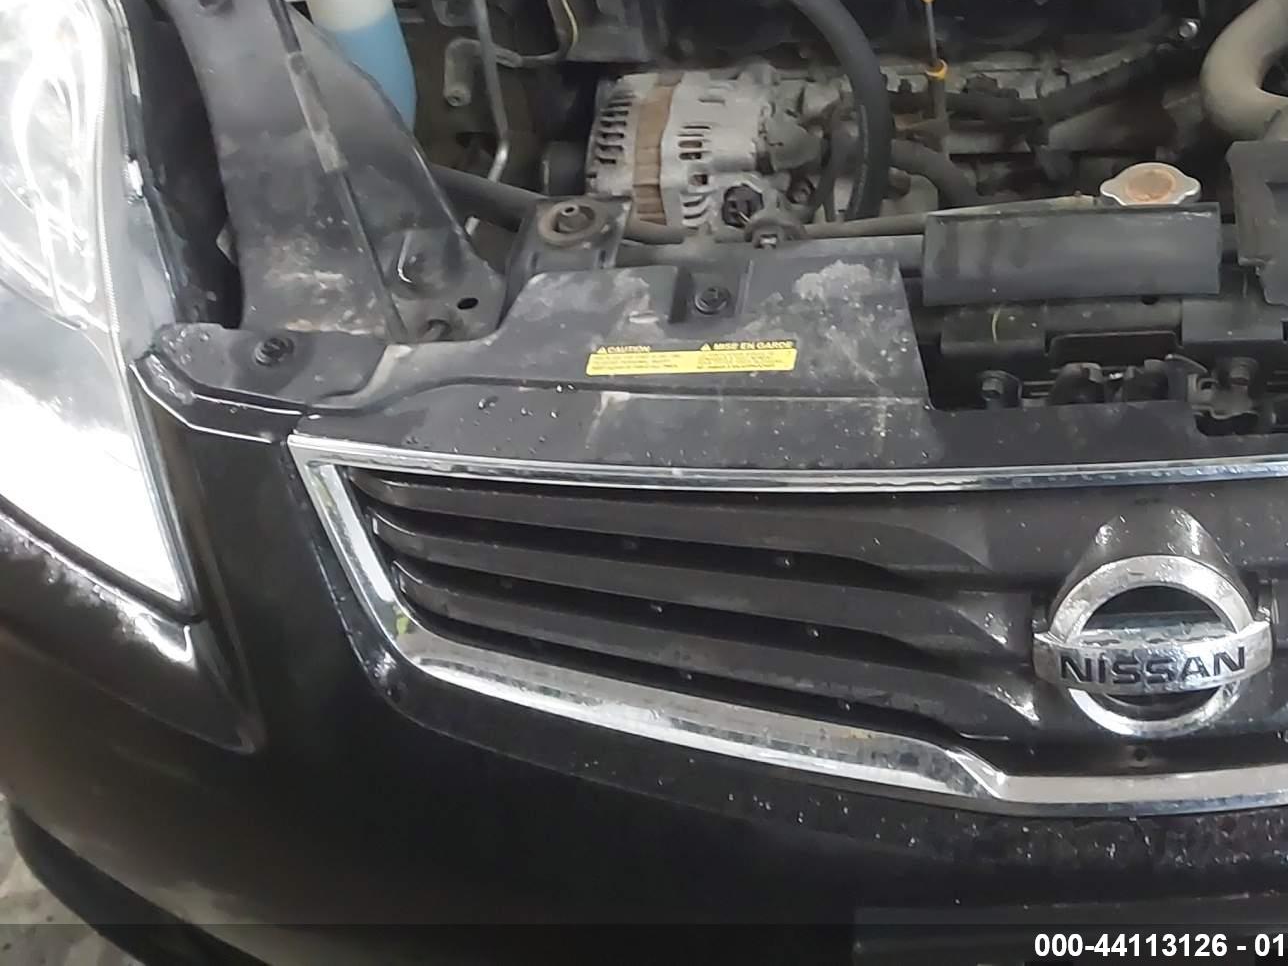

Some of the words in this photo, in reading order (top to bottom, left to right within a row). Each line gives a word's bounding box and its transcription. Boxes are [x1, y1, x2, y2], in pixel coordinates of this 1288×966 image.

[607, 345, 651, 354] CAUTION
[740, 341, 755, 350] EN
[1060, 646, 1246, 684] NISSAN
